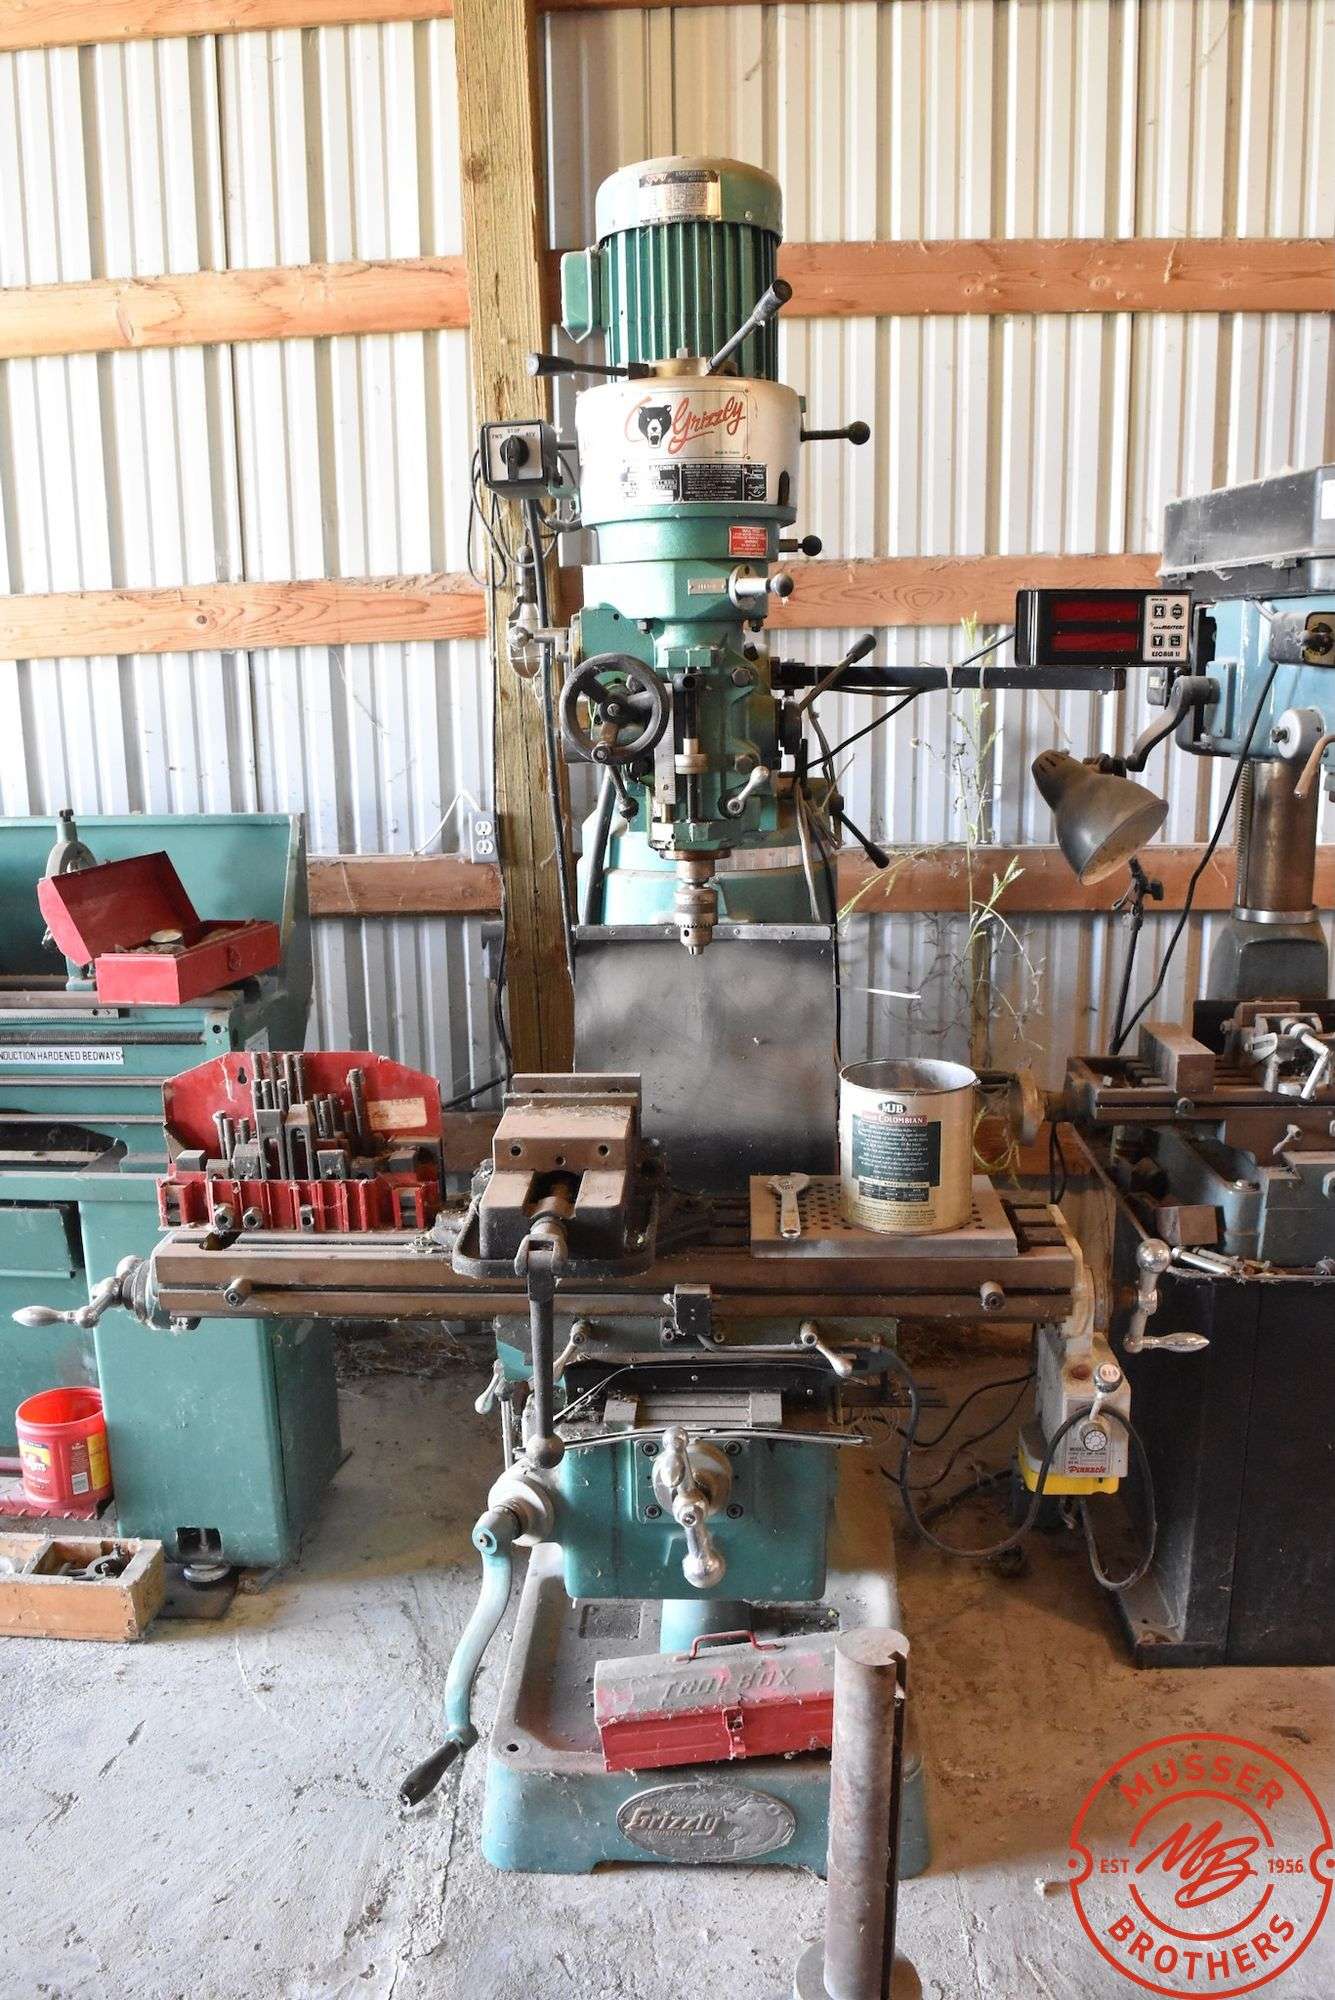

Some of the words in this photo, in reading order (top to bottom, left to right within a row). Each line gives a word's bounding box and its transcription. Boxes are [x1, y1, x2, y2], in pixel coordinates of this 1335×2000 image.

[668, 396, 746, 454] Grizzly
[1156, 607, 1162, 616] X
[1154, 636, 1161, 645] Y
[37, 1051, 81, 1061] HARDENED
[82, 1051, 121, 1061] BEDWAYS
[881, 1103, 904, 1113] MJB
[878, 1114, 923, 1125] COLOMBIAN
[624, 1806, 720, 1836] Grizzly
